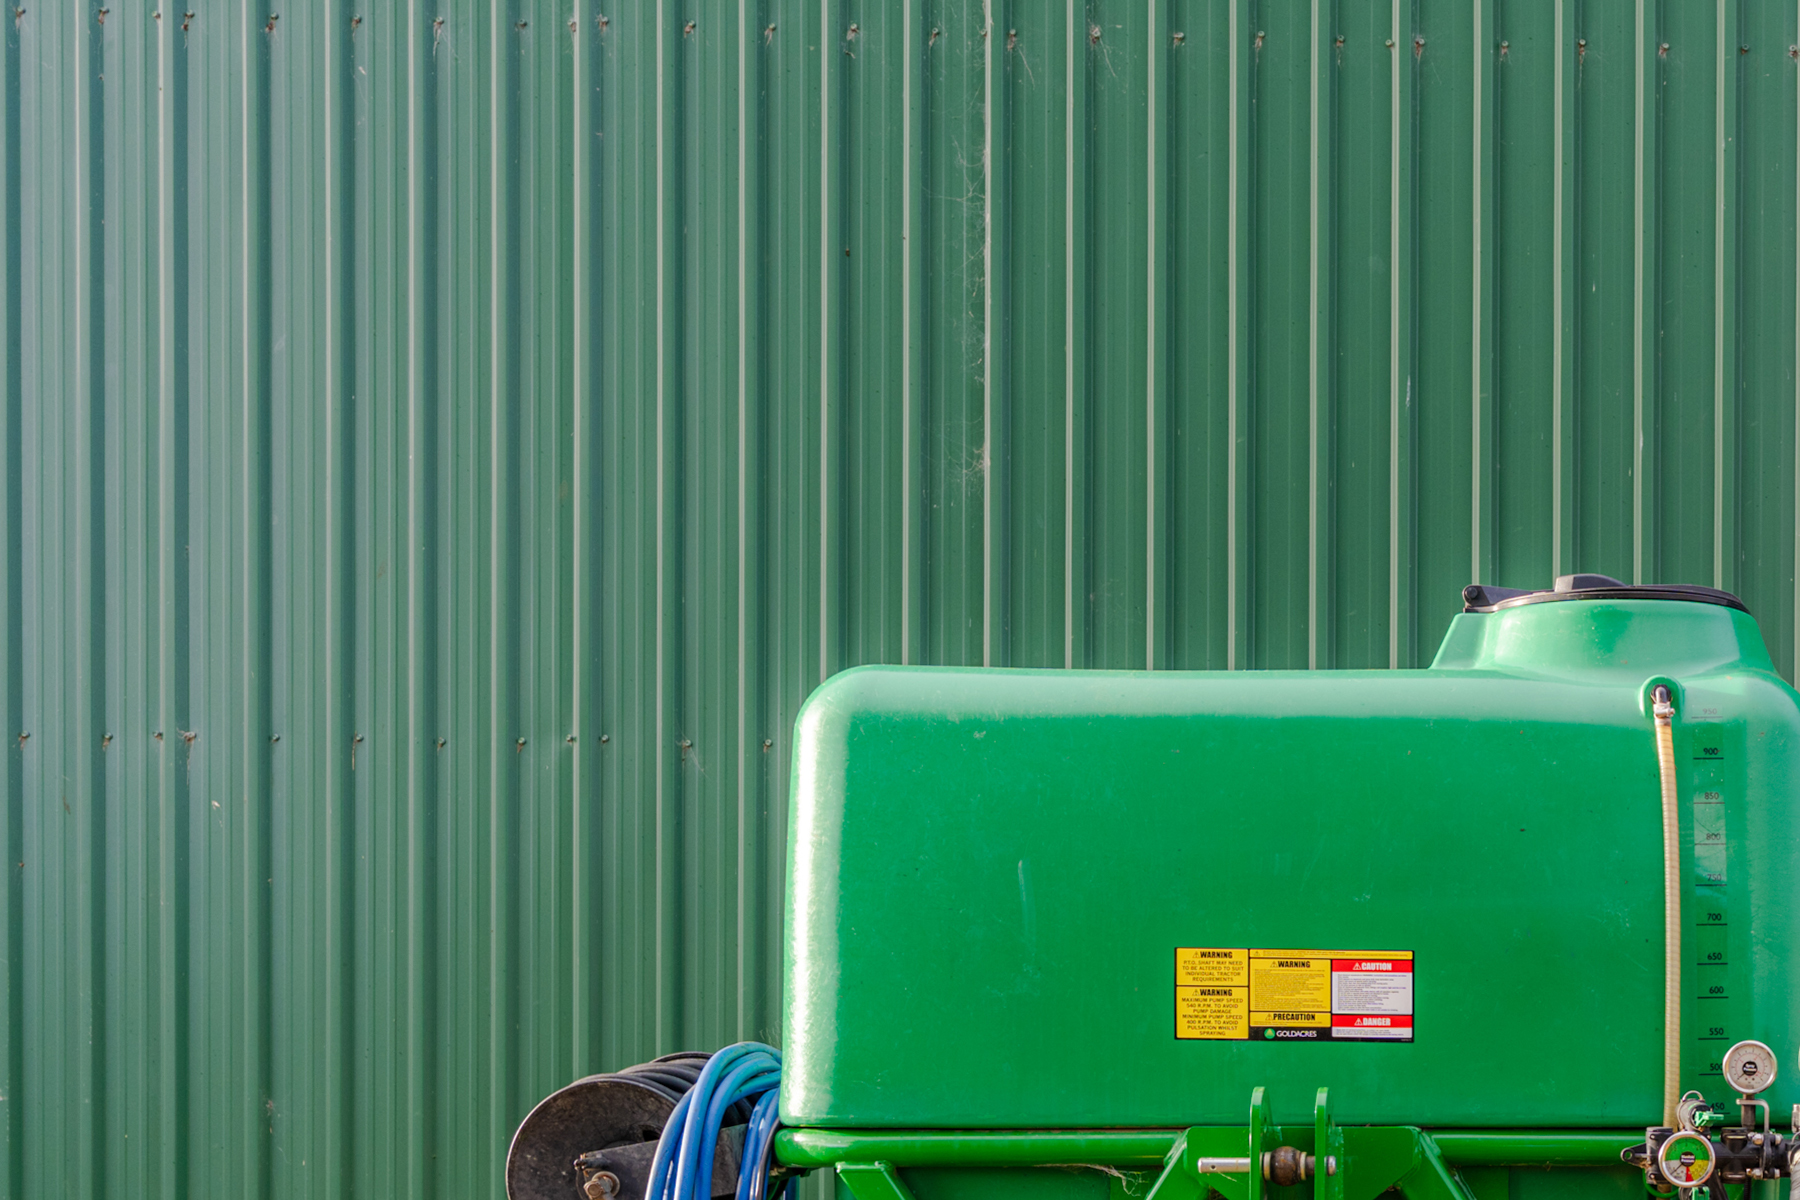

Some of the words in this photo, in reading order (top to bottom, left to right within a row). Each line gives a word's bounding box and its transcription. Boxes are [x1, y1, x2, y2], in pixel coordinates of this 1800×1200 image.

[1704, 792, 1719, 800] 850
[1707, 913, 1722, 921] 700
[1200, 951, 1233, 959] WARNING
[1707, 952, 1722, 960] 650
[1361, 963, 1392, 971] CAUTION
[1709, 986, 1724, 994] 600
[1273, 1013, 1316, 1021] PRECAUTION
[1363, 1017, 1391, 1026] DANGER
[1276, 1030, 1317, 1038] GOLDACRES
[1709, 1028, 1724, 1036] 550
